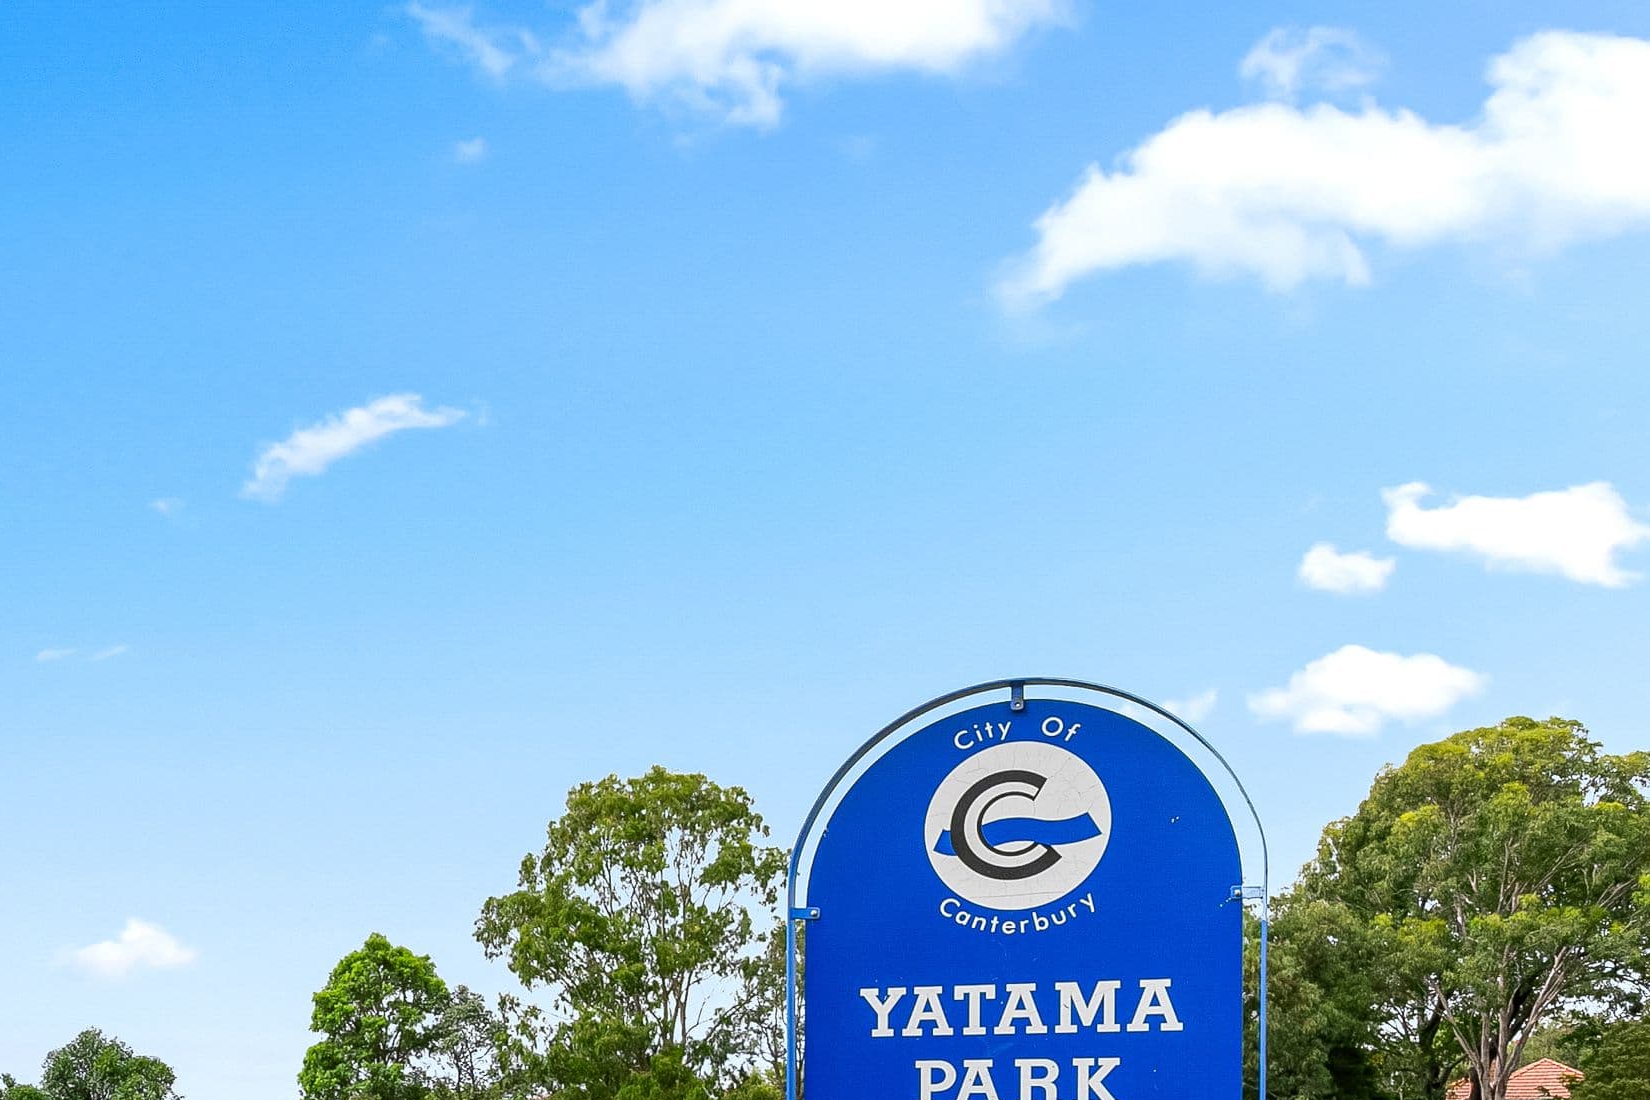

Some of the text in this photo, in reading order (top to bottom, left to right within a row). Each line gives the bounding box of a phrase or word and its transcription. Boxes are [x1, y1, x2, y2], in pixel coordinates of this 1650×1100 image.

[953, 716, 1082, 750] City Of
[939, 892, 1097, 935] Canterbury
[859, 978, 1184, 1038] YATAMA
